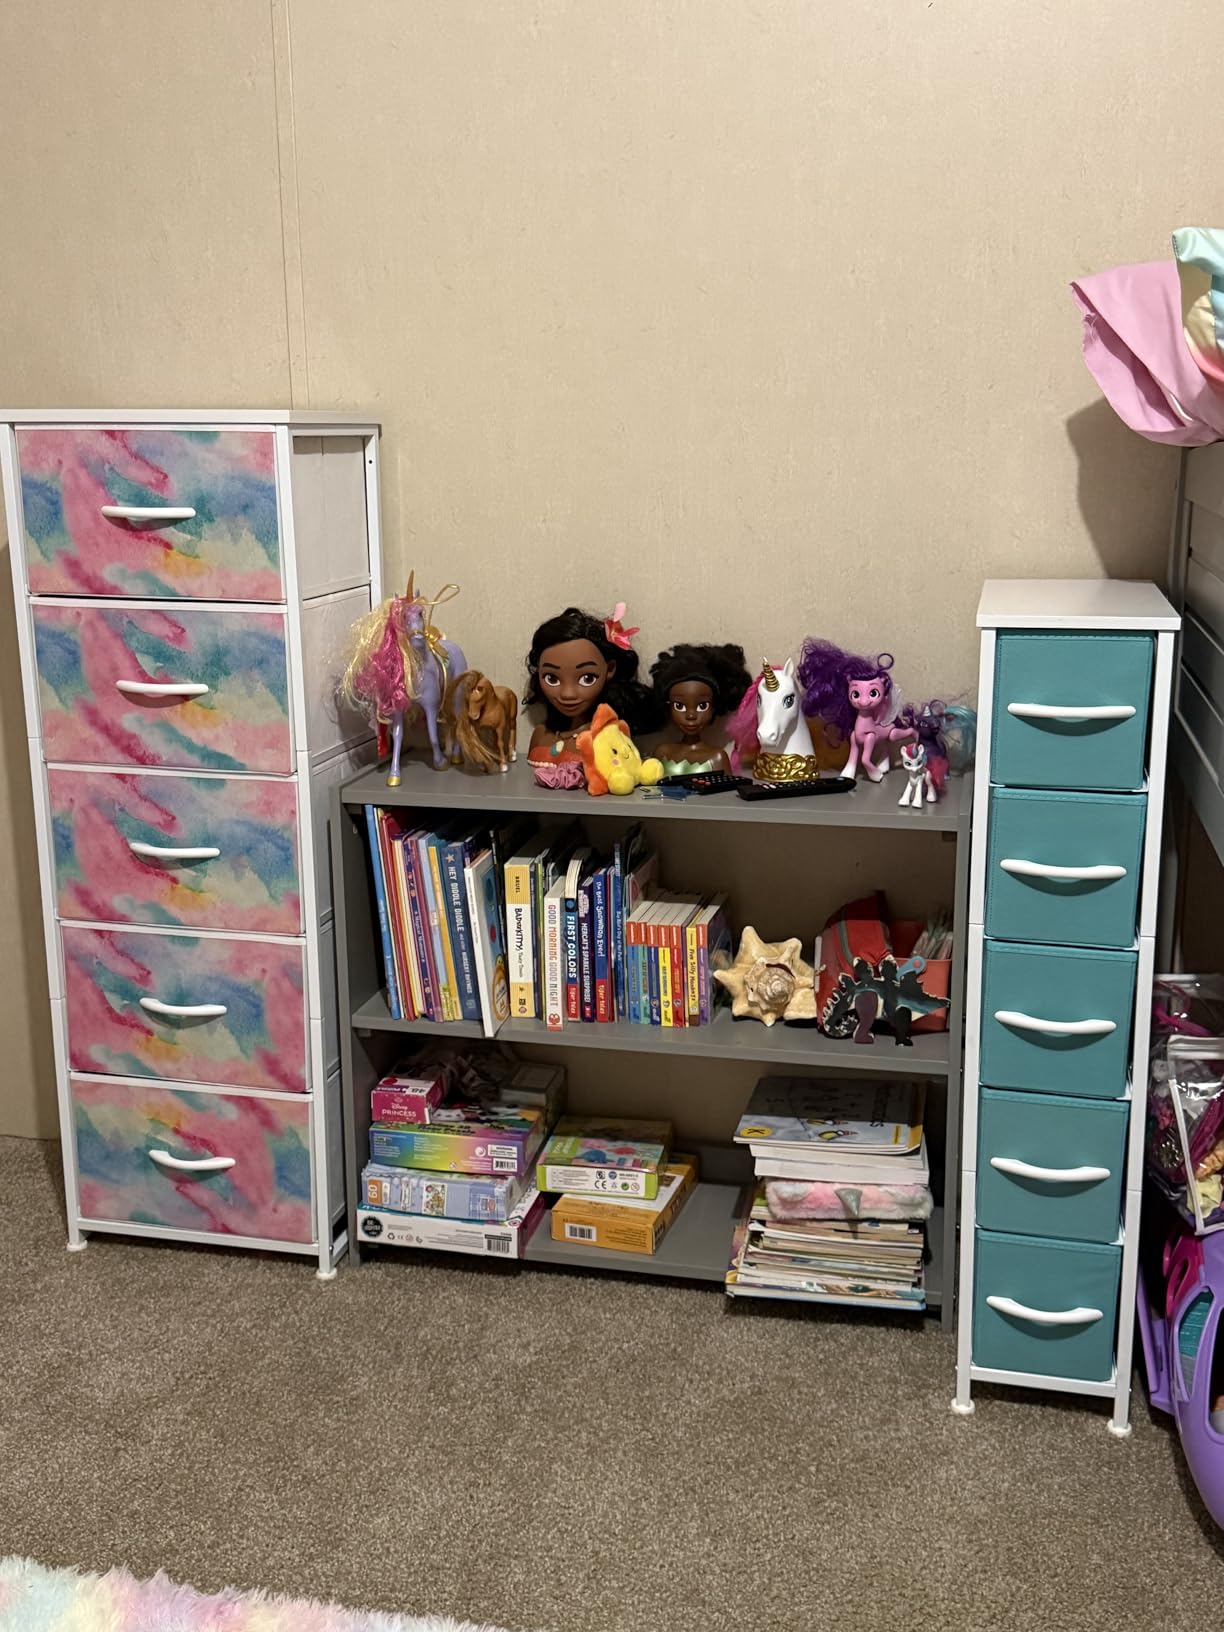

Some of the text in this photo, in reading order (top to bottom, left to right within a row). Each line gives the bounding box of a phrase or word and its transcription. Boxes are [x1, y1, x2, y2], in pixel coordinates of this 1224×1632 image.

[447, 866, 457, 880] HEY
[450, 882, 461, 906] DIDDLE
[454, 908, 465, 932] DIDDLE
[595, 905, 604, 938] Snowman
[567, 915, 577, 978] FIRST COLORS
[581, 922, 589, 949] MERCAT'S
[548, 904, 558, 1007] GOOD MORNING GOOD NIGHT
[596, 939, 605, 957] Ever!
[461, 951, 470, 973] NURSERY
[582, 950, 590, 974] SPARKLE
[464, 974, 473, 994] RHYMES
[583, 975, 591, 1003] SURPRISE!
[381, 1108, 417, 1117] PRINCESS
[368, 1184, 378, 1199] 60
